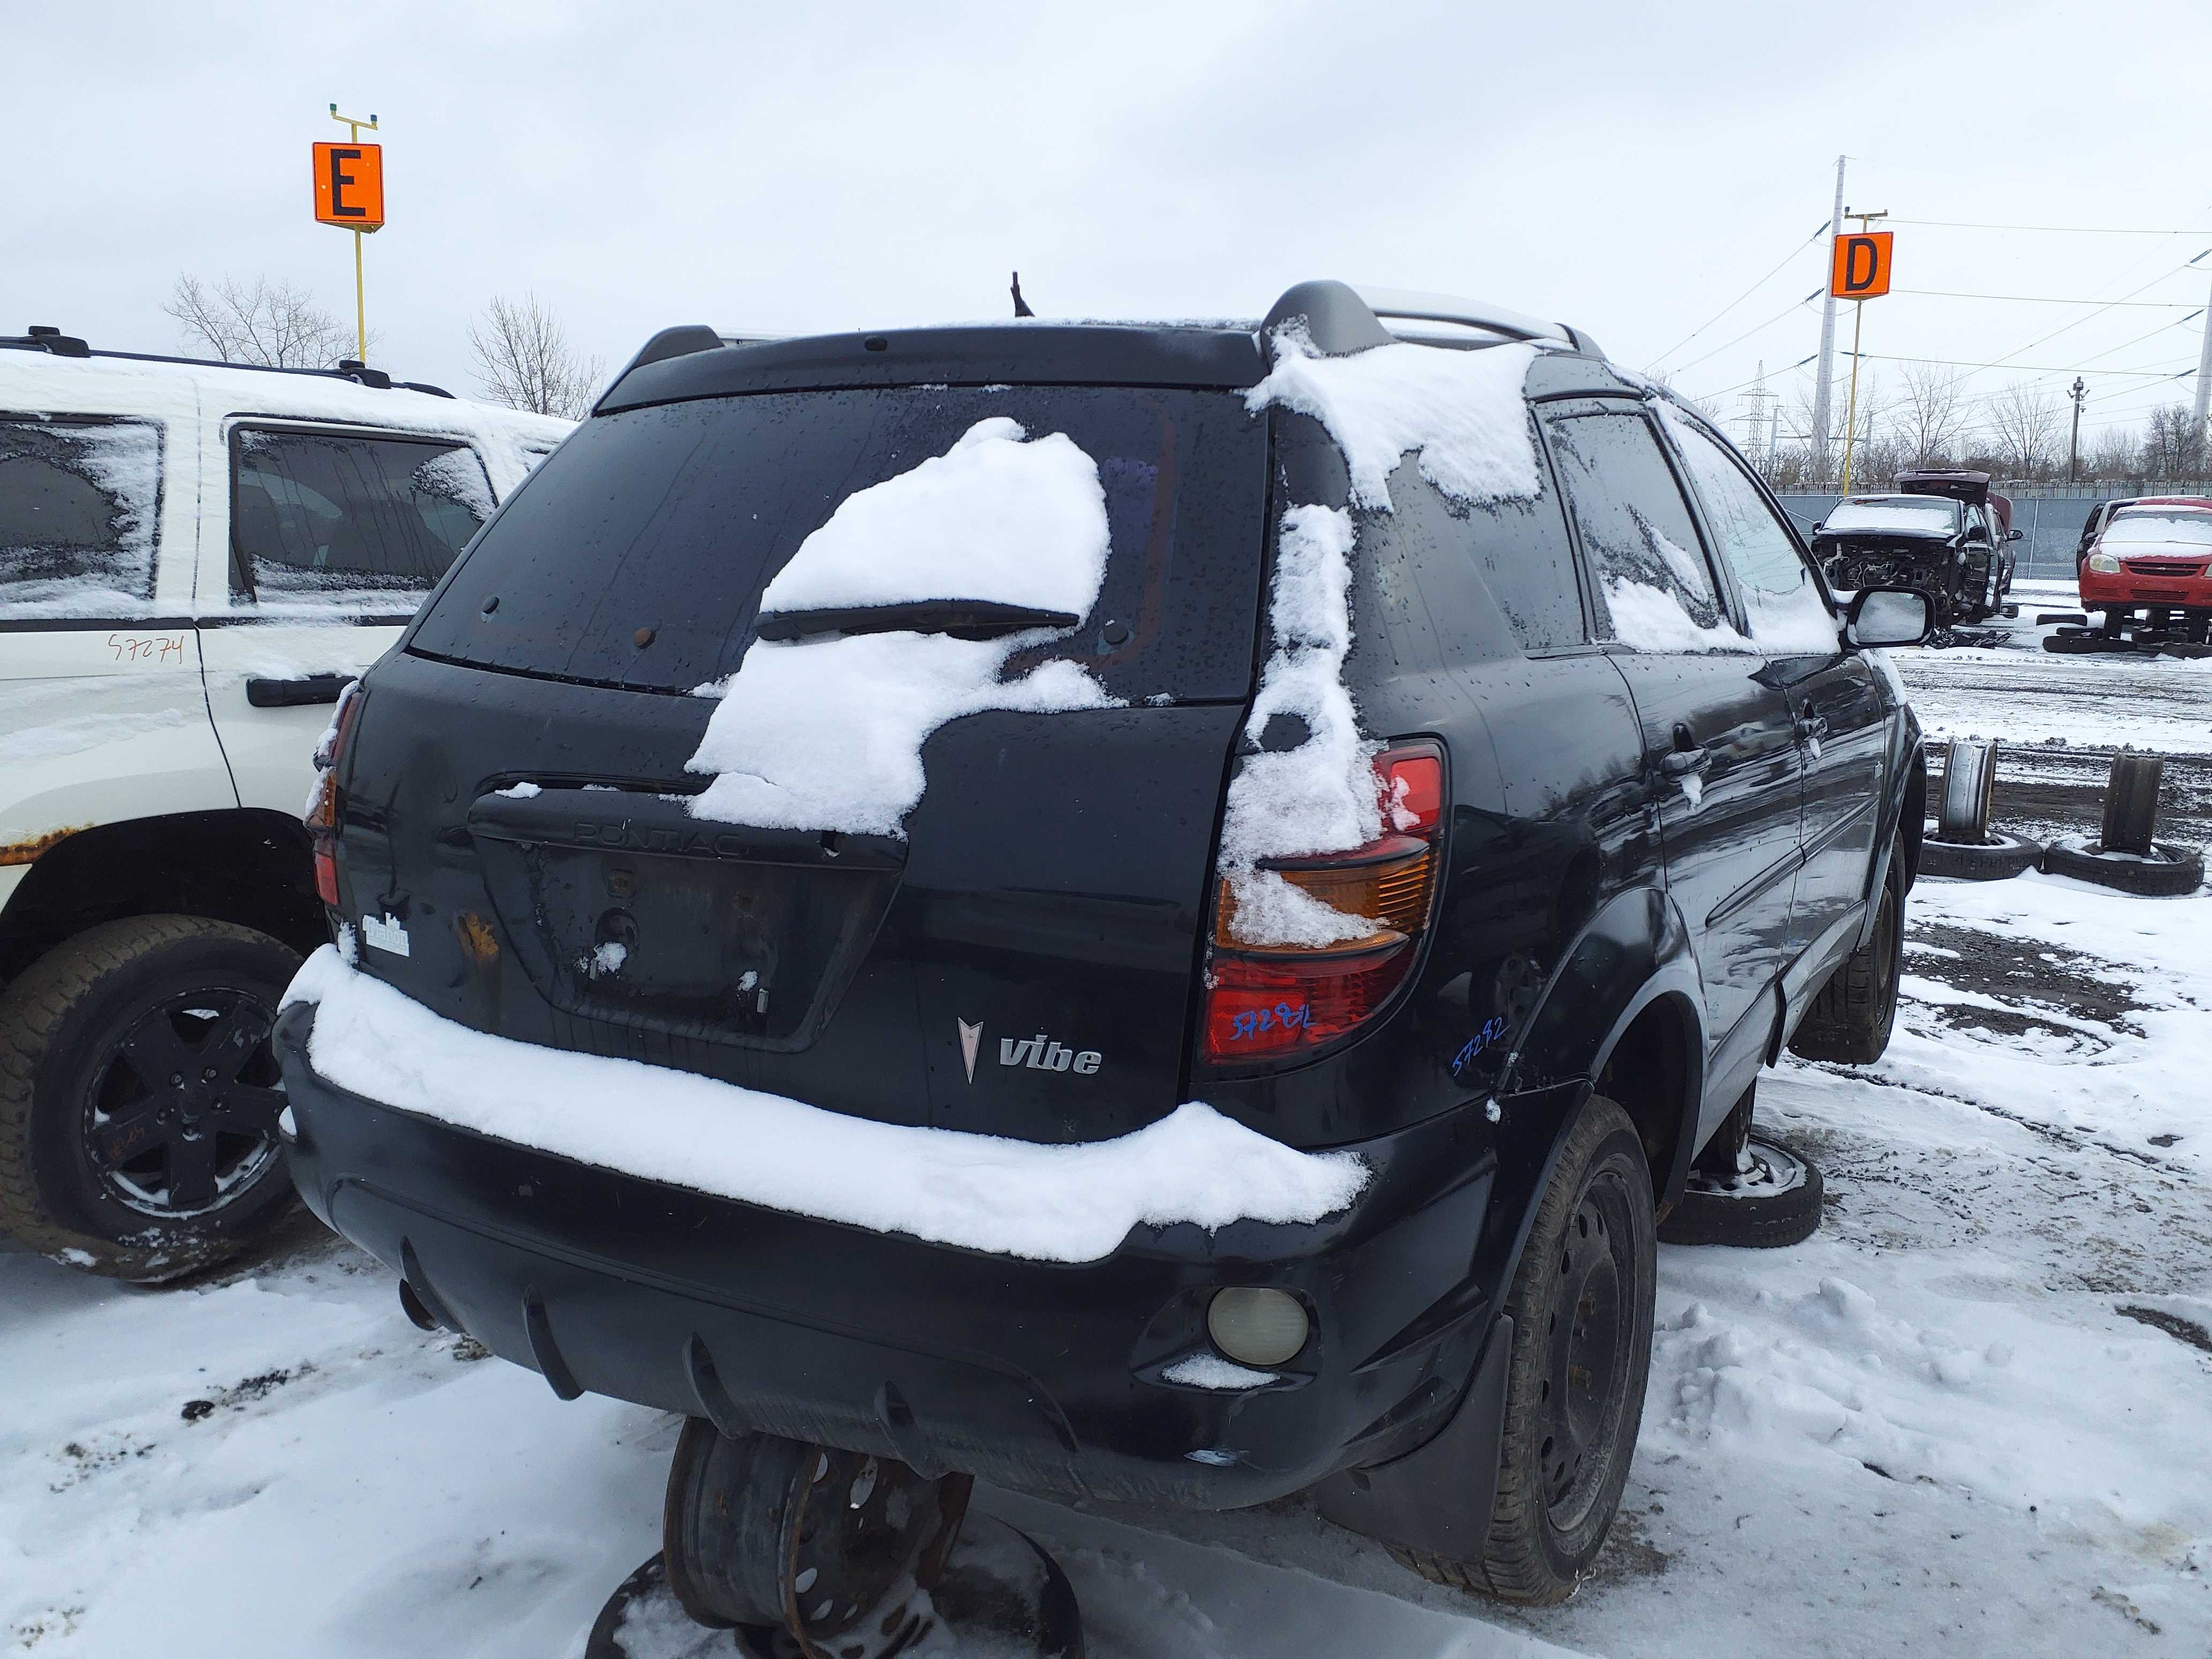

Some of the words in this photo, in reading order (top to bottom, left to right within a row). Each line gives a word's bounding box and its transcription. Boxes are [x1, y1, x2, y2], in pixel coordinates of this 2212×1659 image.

[330, 149, 366, 216] E
[1845, 238, 1878, 291] D
[108, 634, 184, 664] 57274
[573, 821, 745, 857] PONTIAC
[1000, 1034, 1102, 1075] vibe
